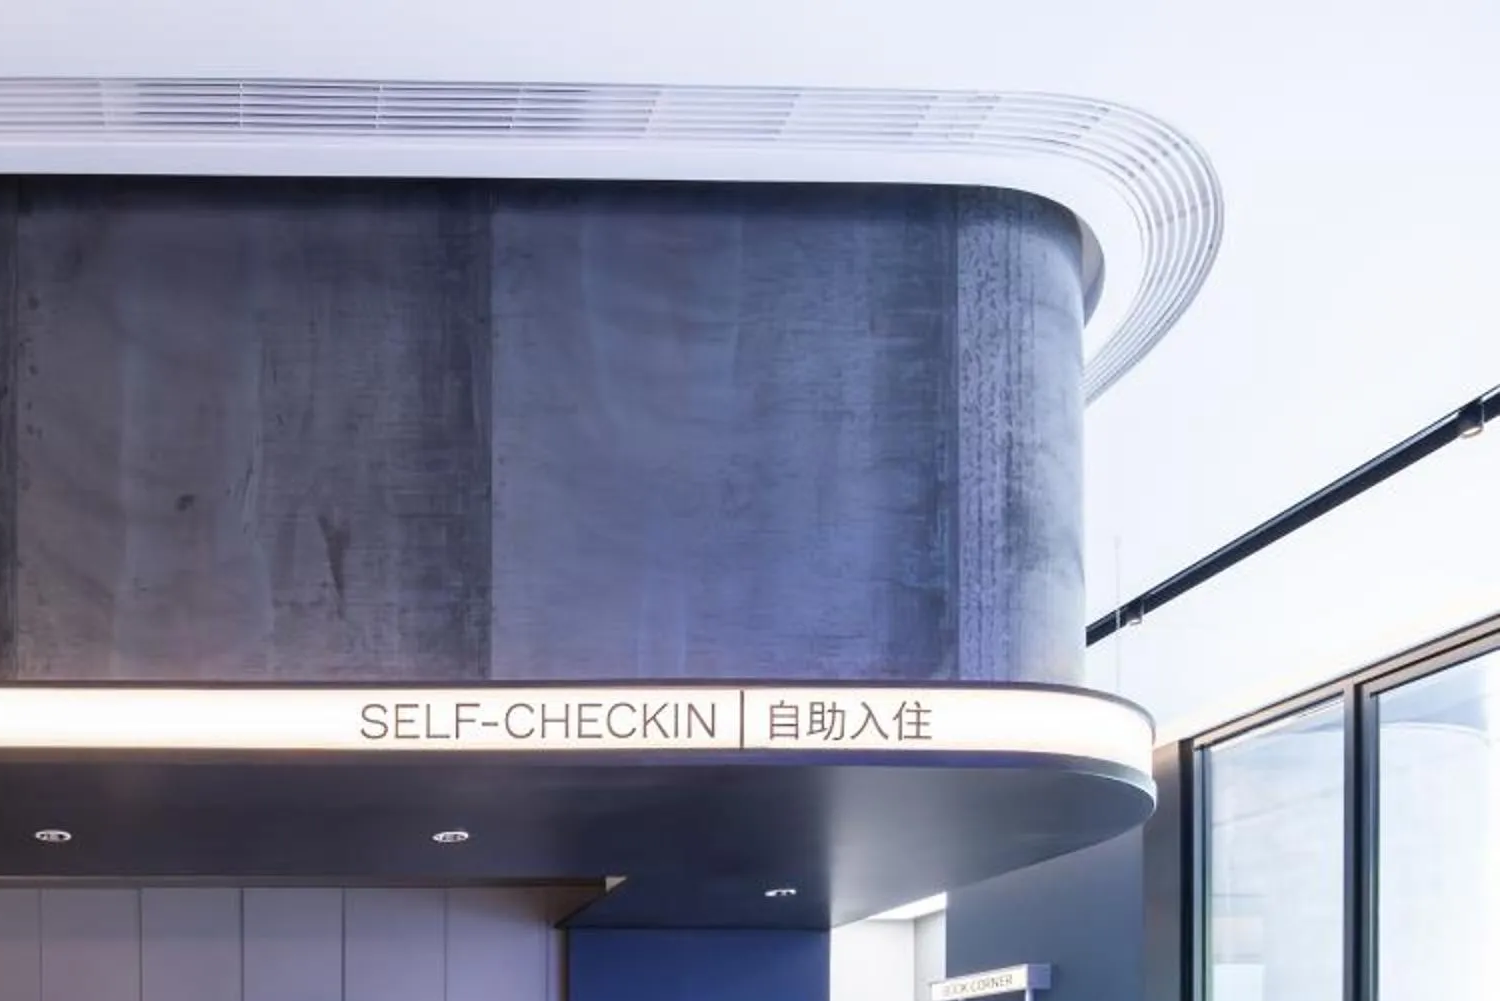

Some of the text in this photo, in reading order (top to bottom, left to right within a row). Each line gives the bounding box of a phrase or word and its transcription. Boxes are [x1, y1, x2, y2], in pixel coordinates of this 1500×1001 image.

[360, 702, 716, 740] SELF-CHECKIN
[769, 700, 932, 741] 自助入住
[970, 974, 1013, 992] CORNER
